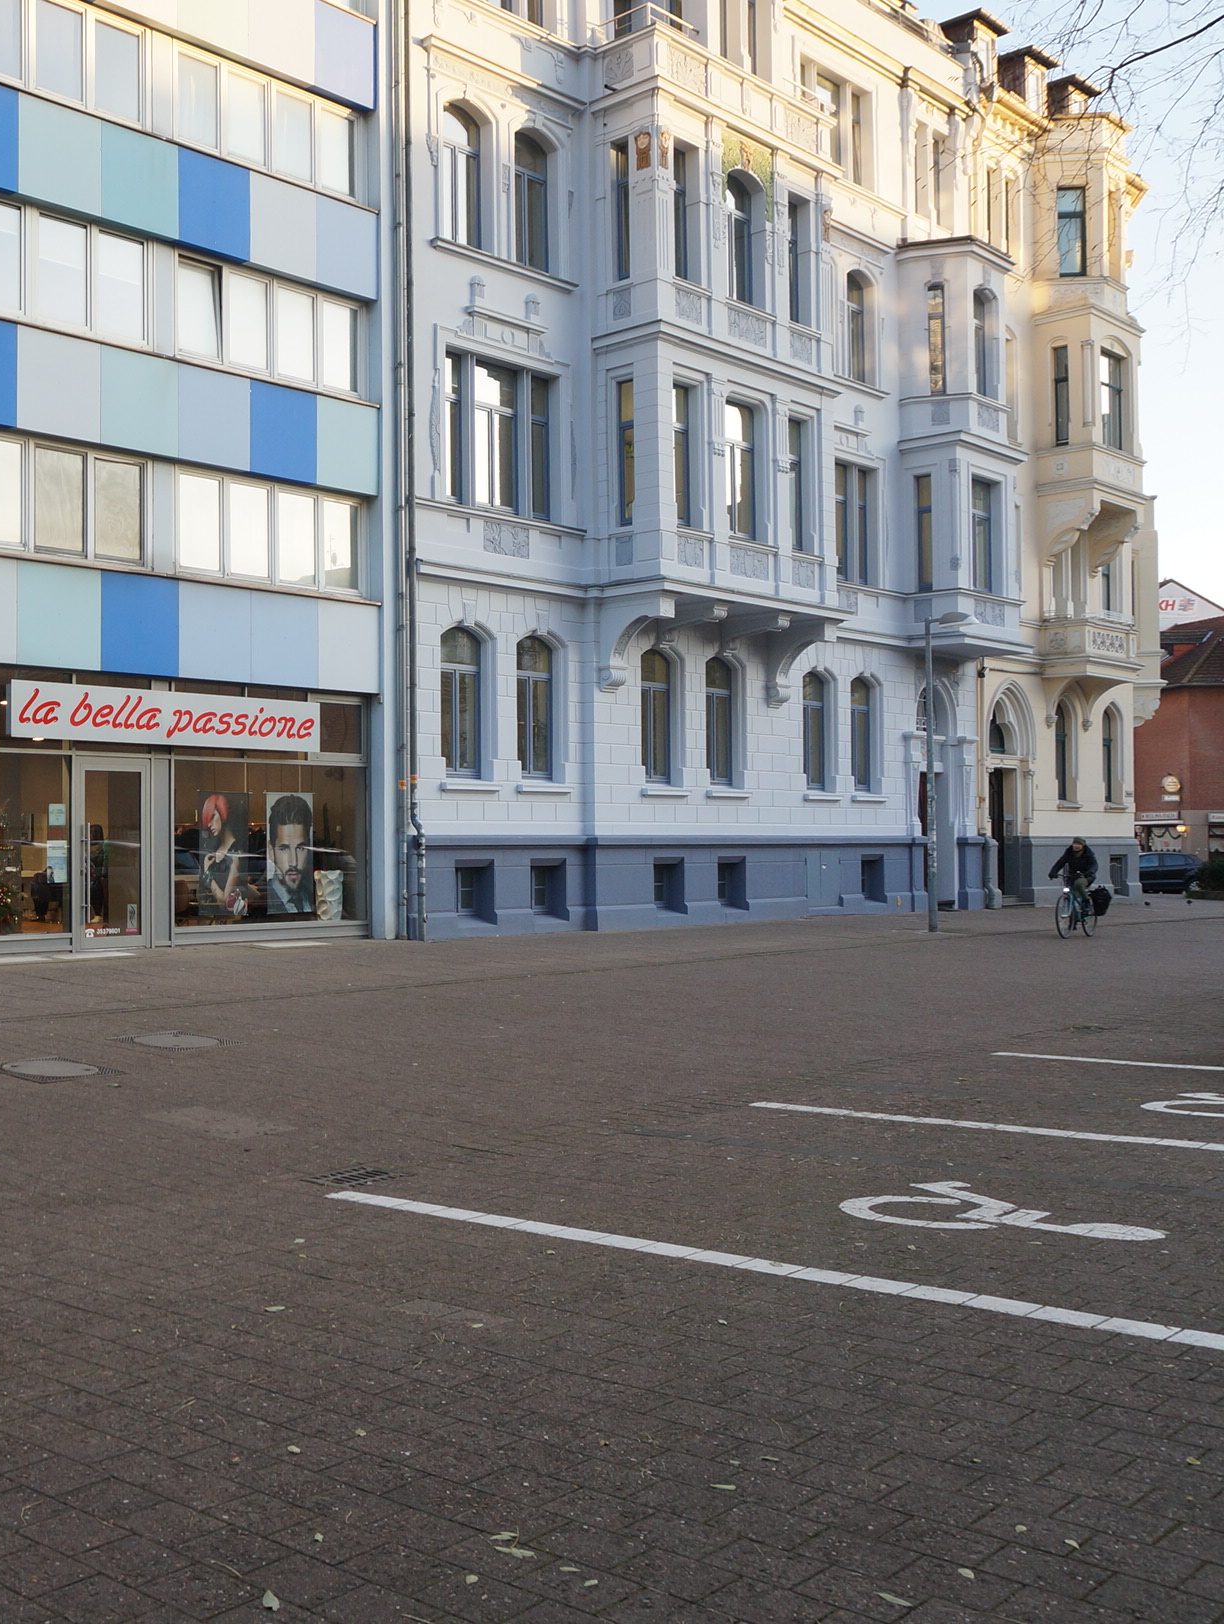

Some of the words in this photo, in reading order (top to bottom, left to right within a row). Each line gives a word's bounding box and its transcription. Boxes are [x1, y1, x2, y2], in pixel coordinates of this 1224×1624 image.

[18, 687, 62, 724] la
[69, 691, 162, 730] bella
[166, 706, 315, 739] passione
